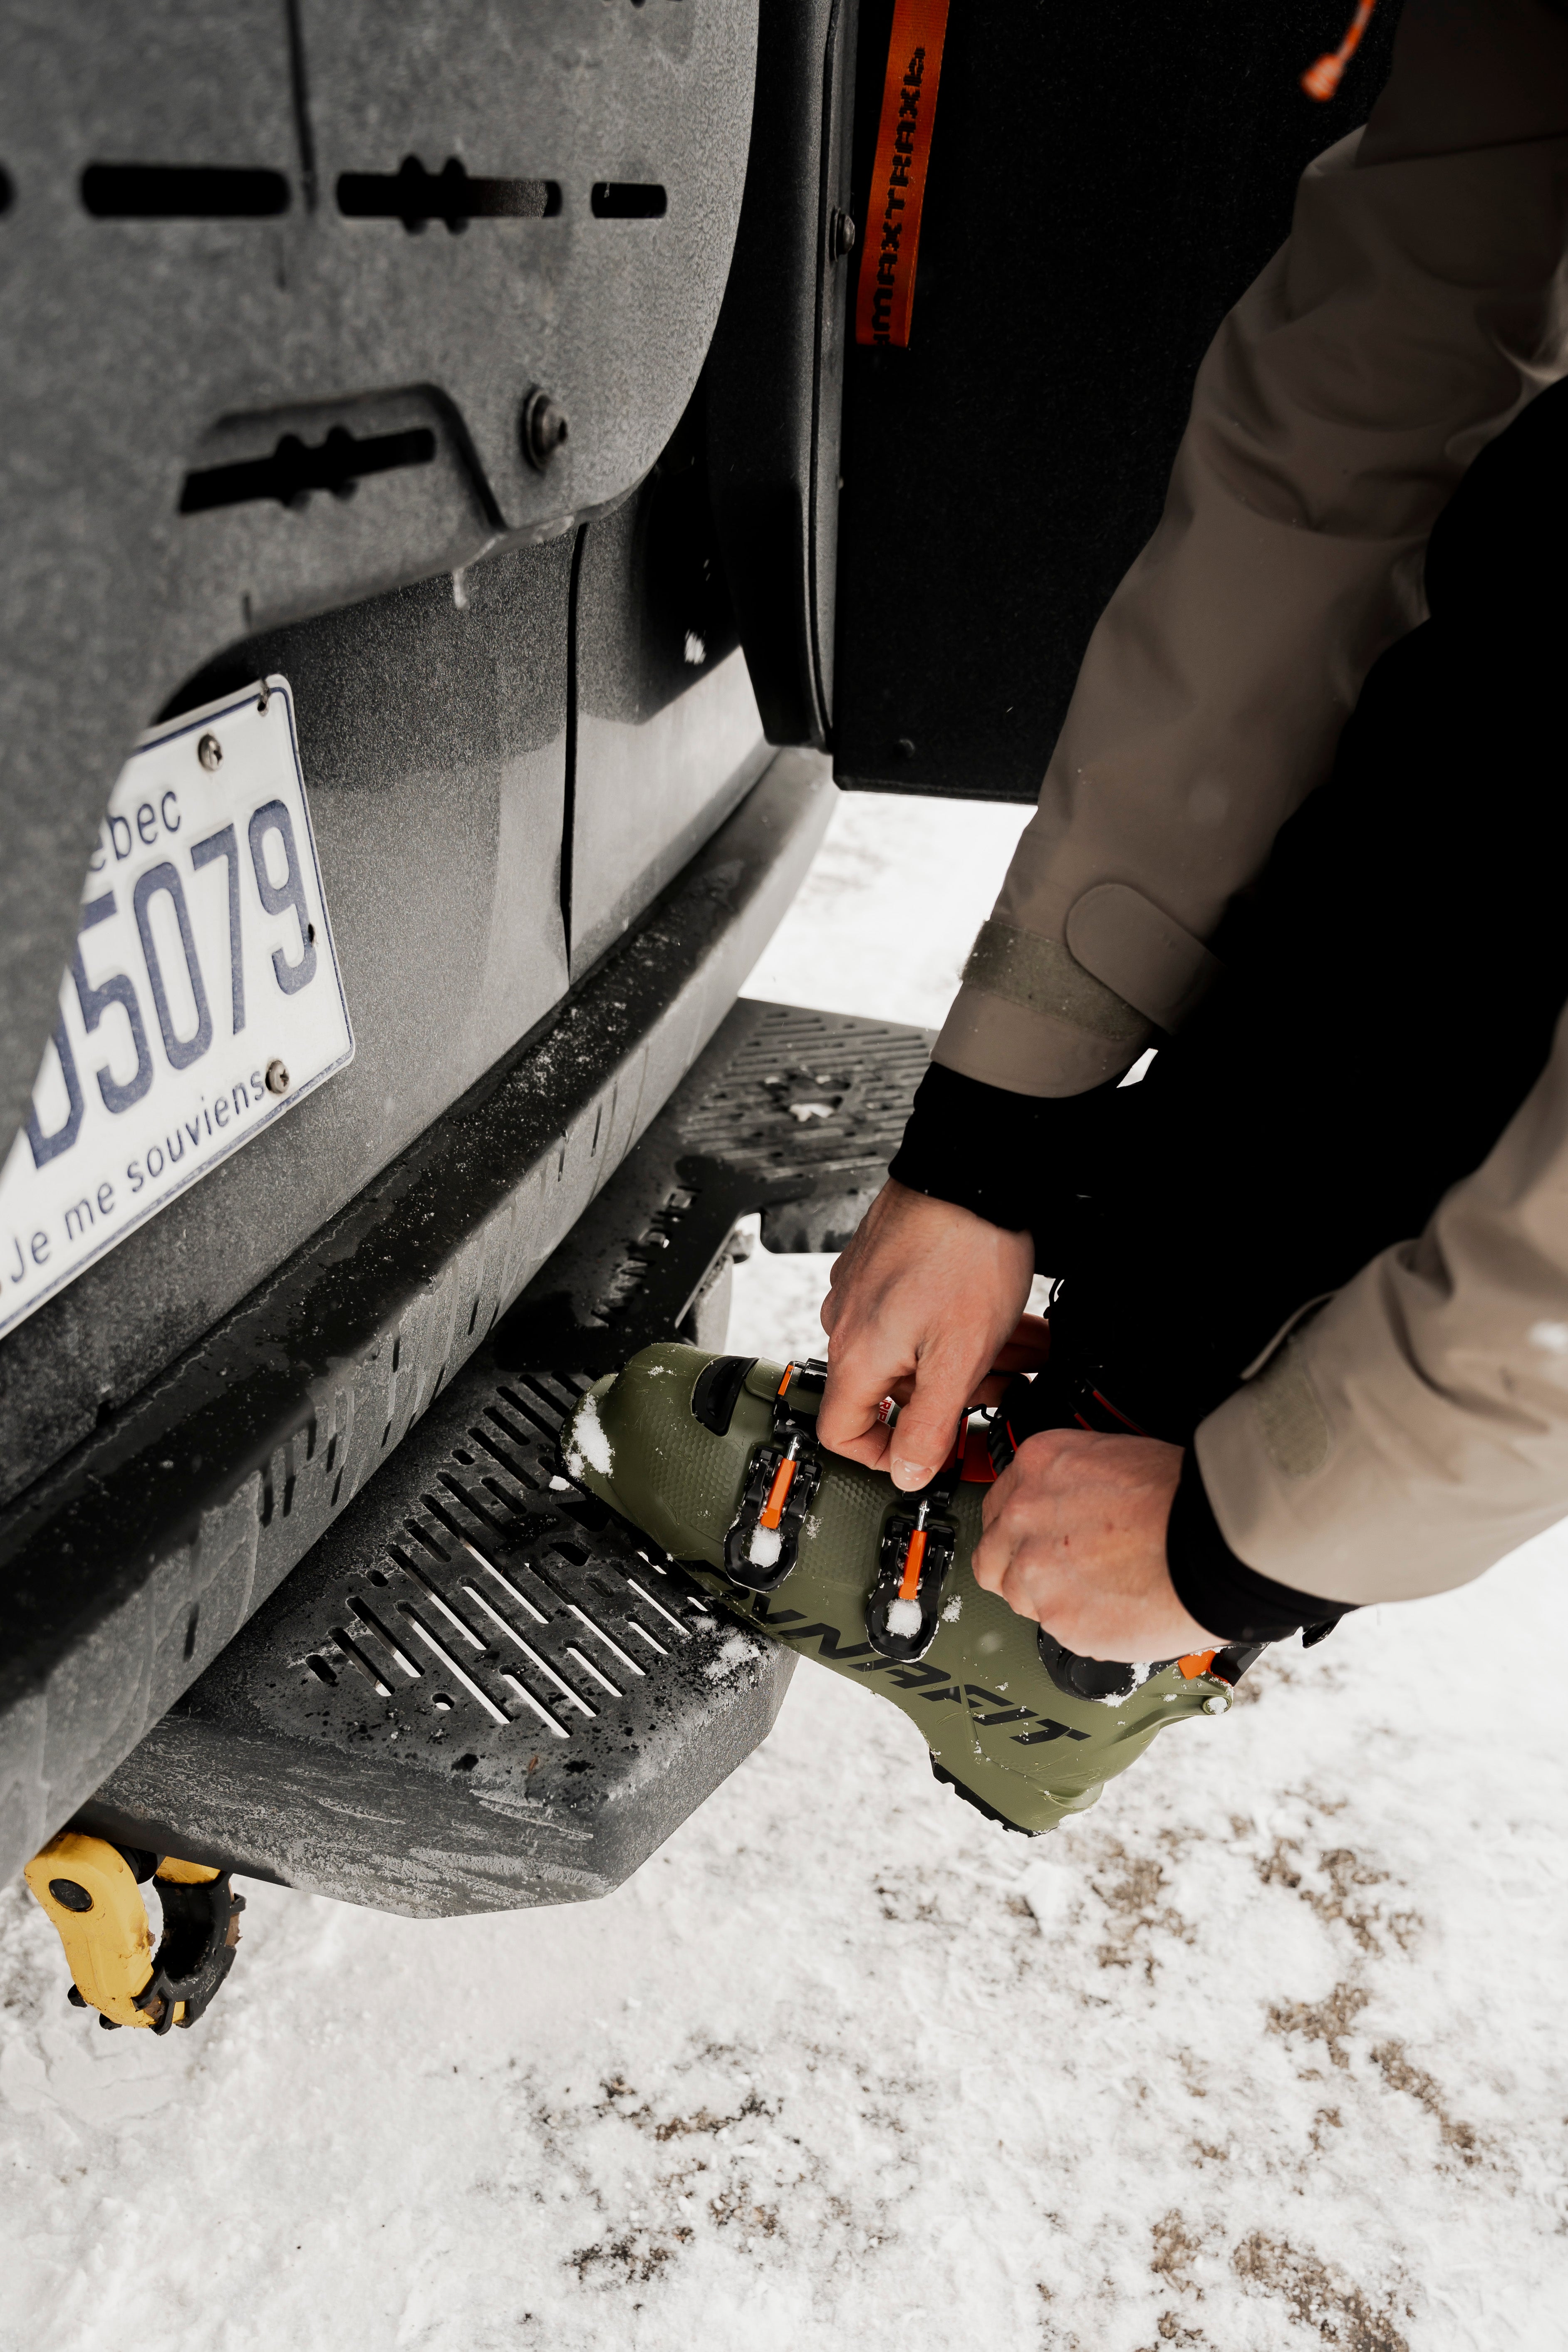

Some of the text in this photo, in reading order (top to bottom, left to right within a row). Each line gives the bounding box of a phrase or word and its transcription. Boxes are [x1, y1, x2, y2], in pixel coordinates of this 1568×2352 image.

[871, 89, 920, 332] MAXTRAX
[11, 1071, 265, 1282] Je me souviens
